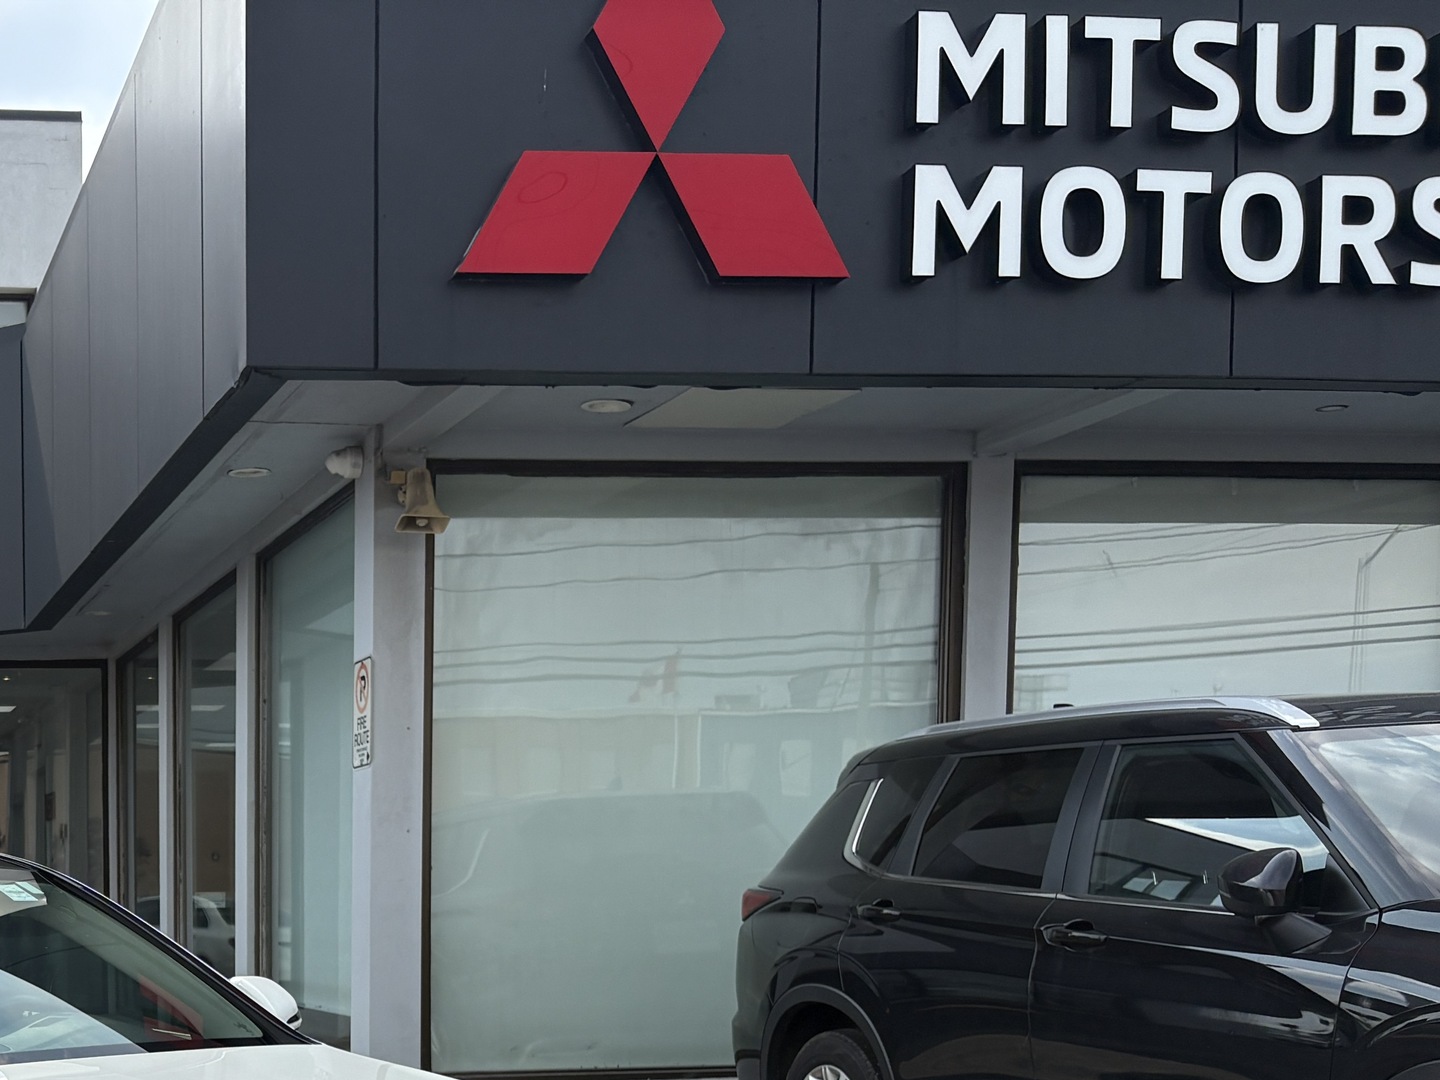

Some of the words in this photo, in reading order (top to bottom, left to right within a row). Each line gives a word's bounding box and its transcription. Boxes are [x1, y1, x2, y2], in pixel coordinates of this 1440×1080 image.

[914, 10, 1428, 136] MITSUB
[357, 715, 368, 731] FIRE
[354, 729, 370, 748] ROUTE
